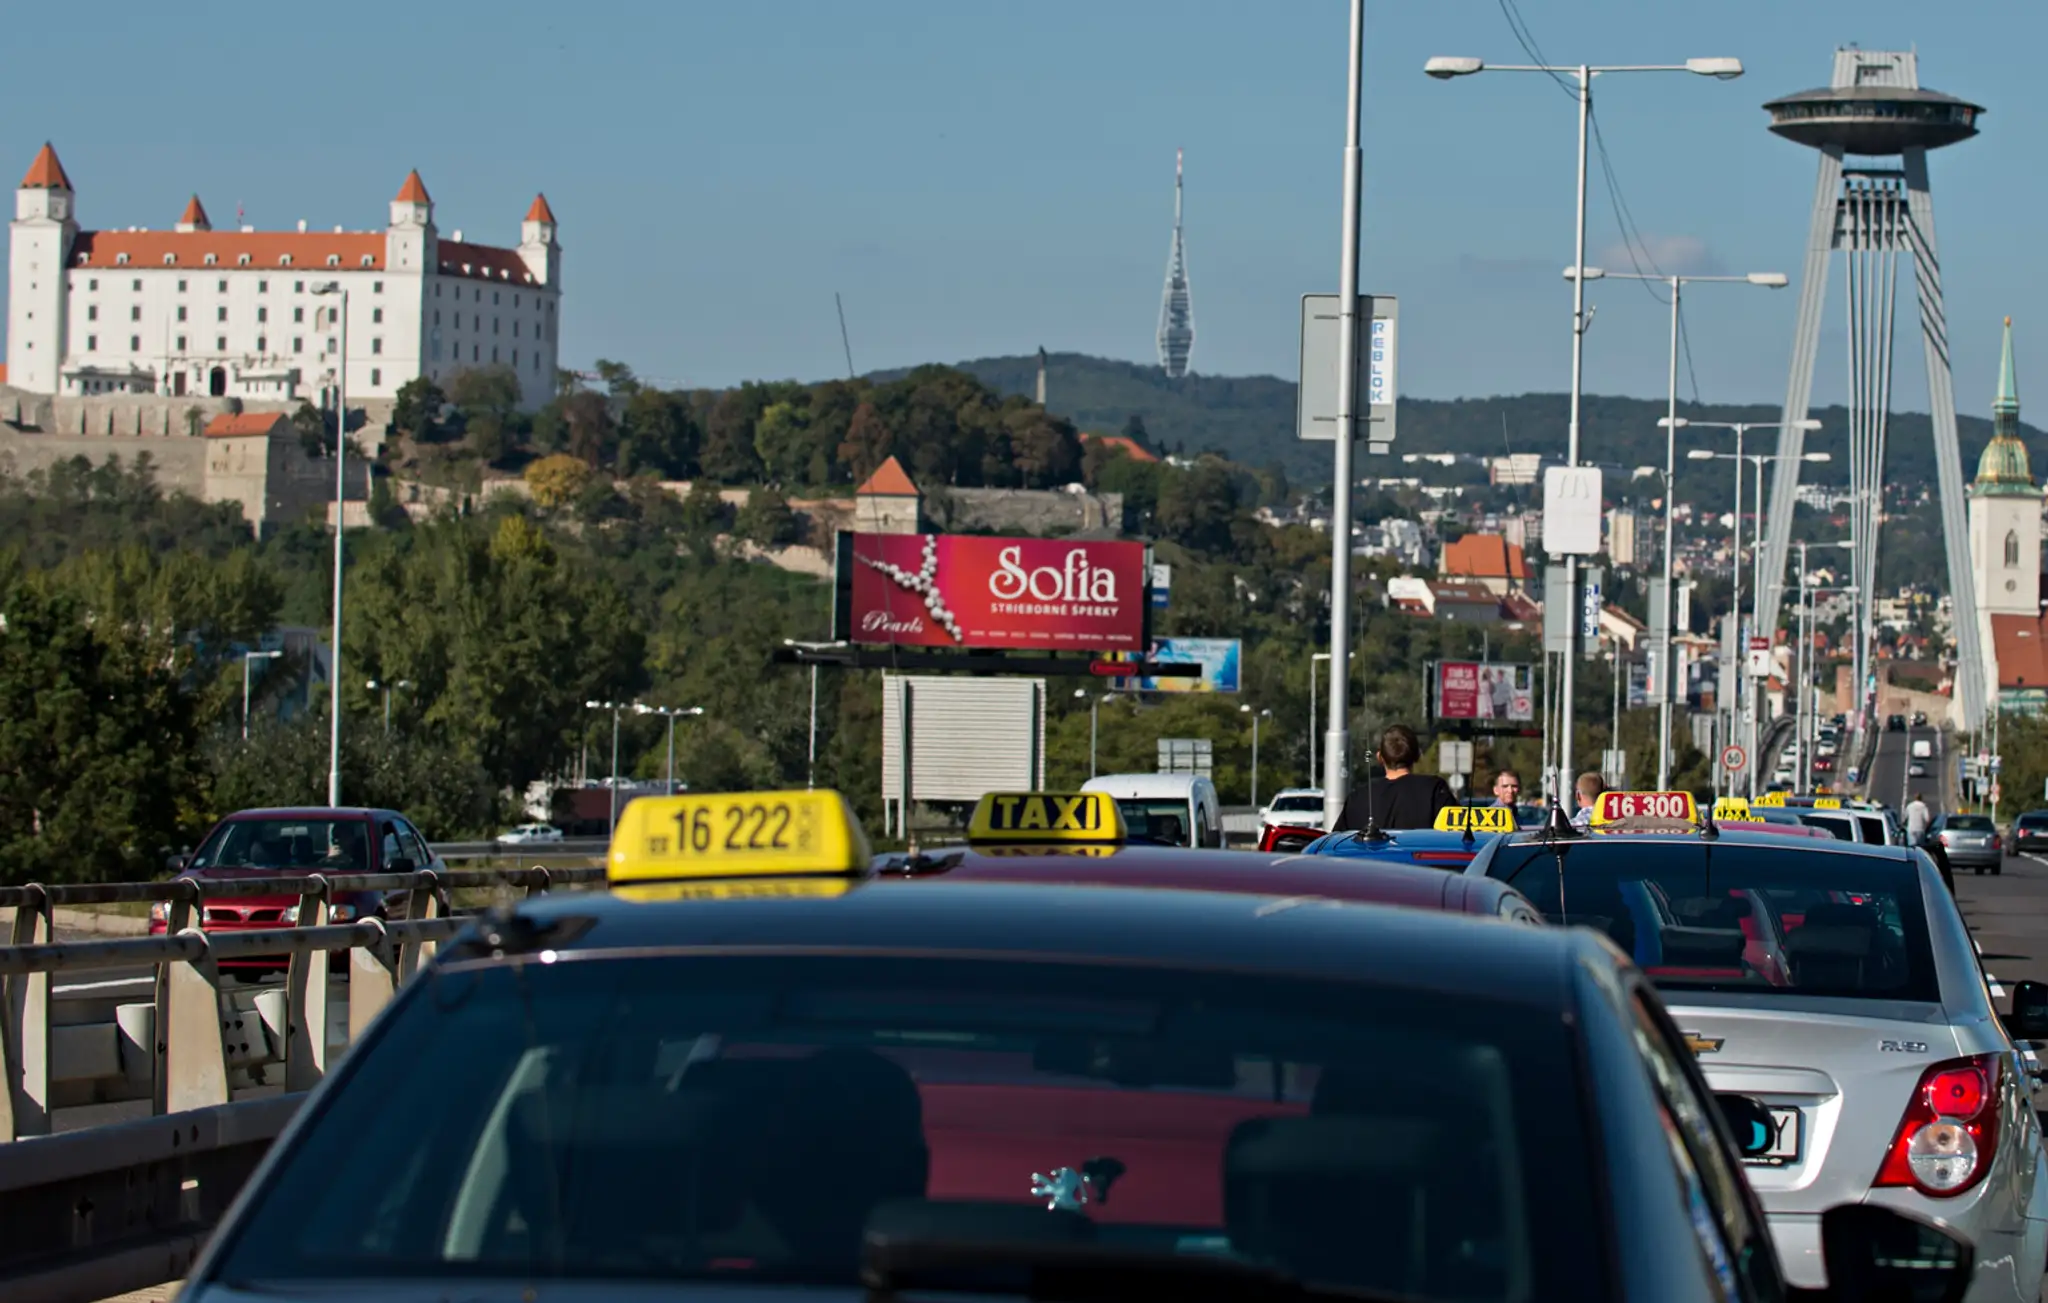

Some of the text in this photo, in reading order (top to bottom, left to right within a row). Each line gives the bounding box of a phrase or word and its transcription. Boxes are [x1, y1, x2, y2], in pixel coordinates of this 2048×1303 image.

[1371, 321, 1384, 401] REBLOK
[989, 545, 1119, 602] Sofia
[991, 602, 1119, 617] STRIEBORNÉ ŠPERKY
[1727, 752, 1740, 764] 60
[996, 796, 1097, 829] TAXI
[1450, 809, 1503, 826] TAXI
[1609, 796, 1683, 818] 16 300
[672, 805, 711, 852] 16
[725, 803, 791, 850] 222
